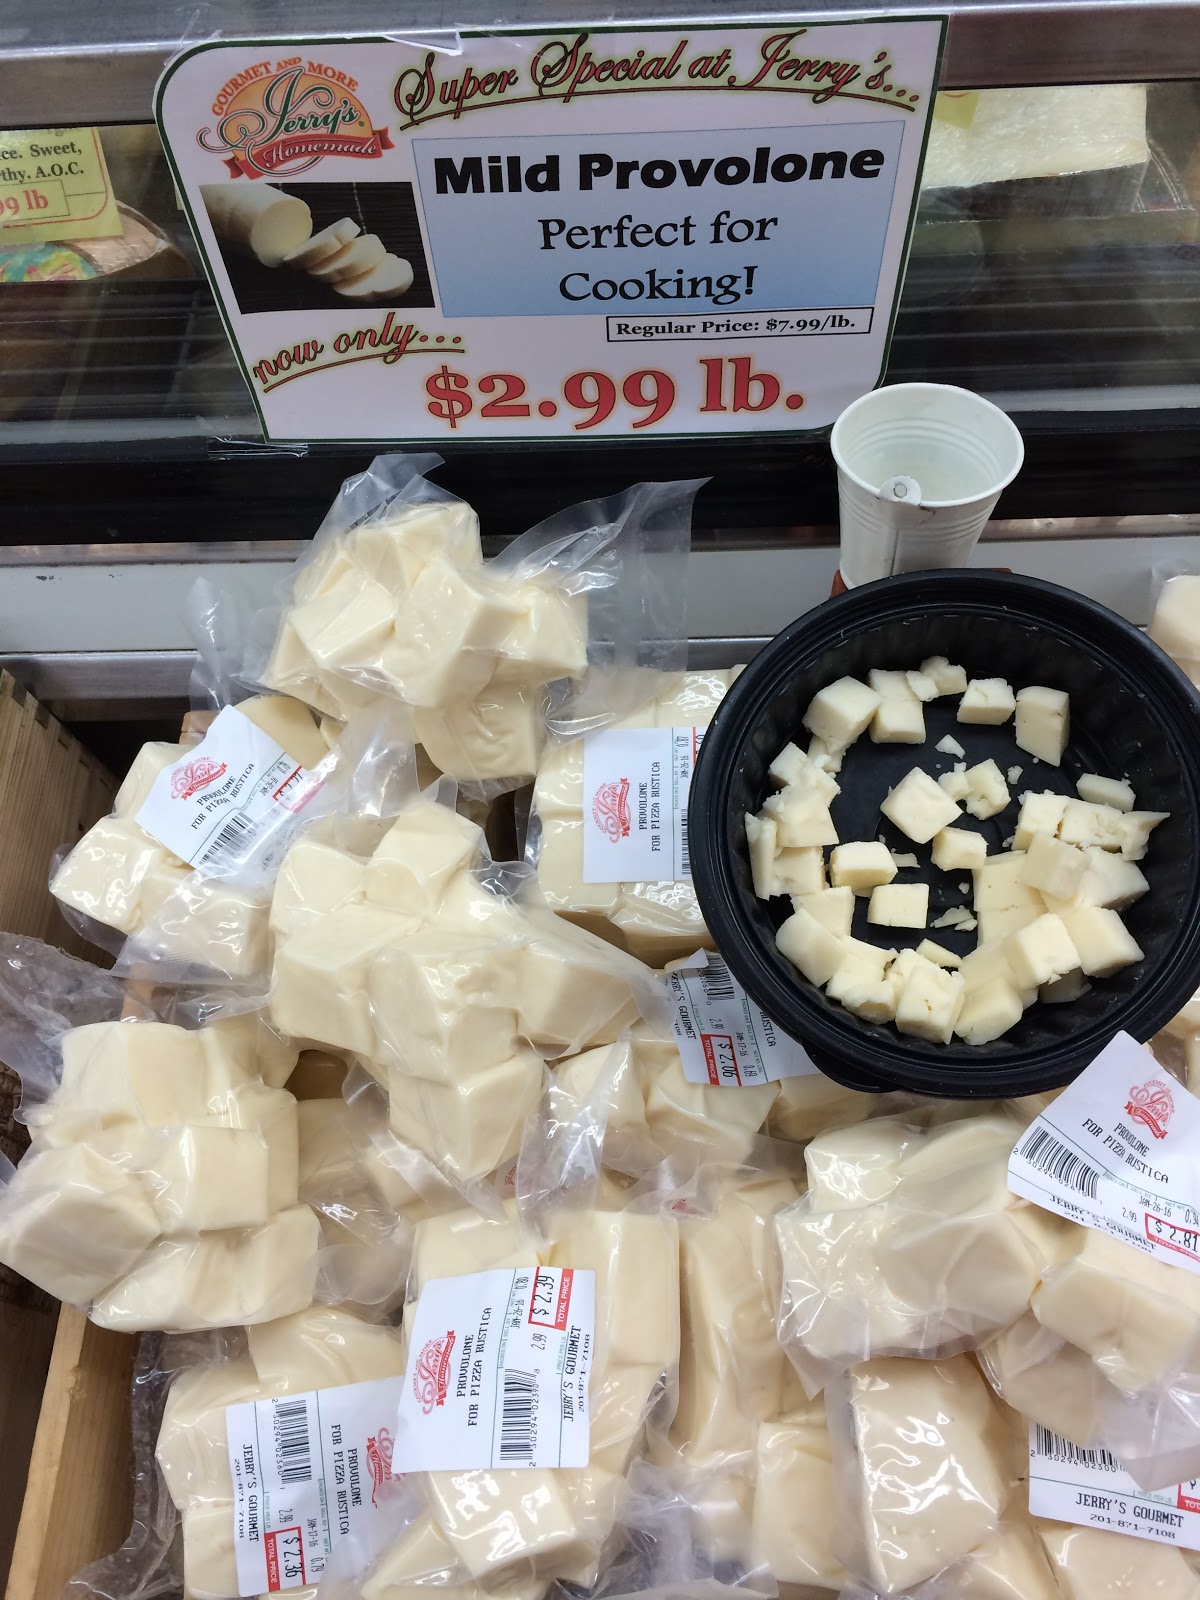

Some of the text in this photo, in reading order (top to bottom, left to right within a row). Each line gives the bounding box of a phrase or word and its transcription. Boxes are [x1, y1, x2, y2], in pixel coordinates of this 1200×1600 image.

[212, 57, 358, 116] GOURMET AND MORE
[394, 52, 518, 125] Super
[530, 32, 688, 103] Special
[688, 49, 731, 79] at
[197, 66, 359, 177] Jerry's
[0, 141, 82, 160] ce. Sweet,
[35, 162, 84, 179] A.O.C.
[263, 138, 376, 168] Homemade
[434, 146, 885, 194] Mild Provolone
[23, 189, 49, 210] lb
[538, 210, 778, 251] Perfect for
[559, 266, 758, 305] Cooking!
[616, 315, 855, 337] Regular Price: $7.99/lb.
[253, 312, 461, 384] now only...
[426, 357, 804, 429] $2.99 lb.
[191, 813, 206, 830] FOR
[230, 763, 254, 798] RUSTICA
[639, 783, 647, 830] PROVOLONE
[651, 762, 660, 851] FOR PIZZA RUSTICA
[679, 1006, 696, 1039] GOURMET
[709, 1018, 724, 1030] 2.99
[704, 1040, 716, 1079] TOTAL PRICE
[736, 1032, 747, 1056] JAN-17-16
[720, 1054, 737, 1078] 2.06
[1082, 1118, 1103, 1137] FOR
[1103, 1135, 1125, 1158] PIZZA
[1125, 1153, 1169, 1184] RUSTICA
[1113, 1122, 1150, 1157] PROVOLONE
[1050, 1195, 1100, 1223] JERRY'S
[1106, 1221, 1156, 1250] GOURMET
[1139, 1196, 1172, 1217] JAN-26-16
[1155, 1220, 1163, 1234] $
[1170, 1229, 1199, 1252] 2.81
[510, 1299, 524, 1329] JAN-26-16
[532, 1275, 555, 1316] $ 2.39
[557, 1277, 570, 1323] TOTAL PRICE
[531, 1333, 548, 1351] 2.99
[456, 1334, 474, 1397] PROVOLONE
[468, 1307, 492, 1426] FOR PIZZA RUSTICA
[563, 1325, 581, 1422] JERRY'S GOURMET
[578, 1334, 590, 1412] 201-871-7108
[275, 1447, 283, 1476] 02360
[331, 1424, 350, 1535] FOR PIZZA RUSTICA
[348, 1448, 362, 1507] PROVOLONE
[234, 1458, 244, 1538] 201-871-7108
[243, 1444, 259, 1541] JERRY'S GOURMET
[1076, 1493, 1126, 1514] JERRY'S
[1133, 1506, 1184, 1528] GOURMET
[279, 1508, 293, 1523] 2.99
[307, 1518, 319, 1548] JAN-17-16
[1090, 1514, 1176, 1539] 201-871-7108
[267, 1540, 278, 1583] TOTAL PRICE
[282, 1536, 303, 1578] $ 2.36
[310, 1557, 325, 1573] 0.79
